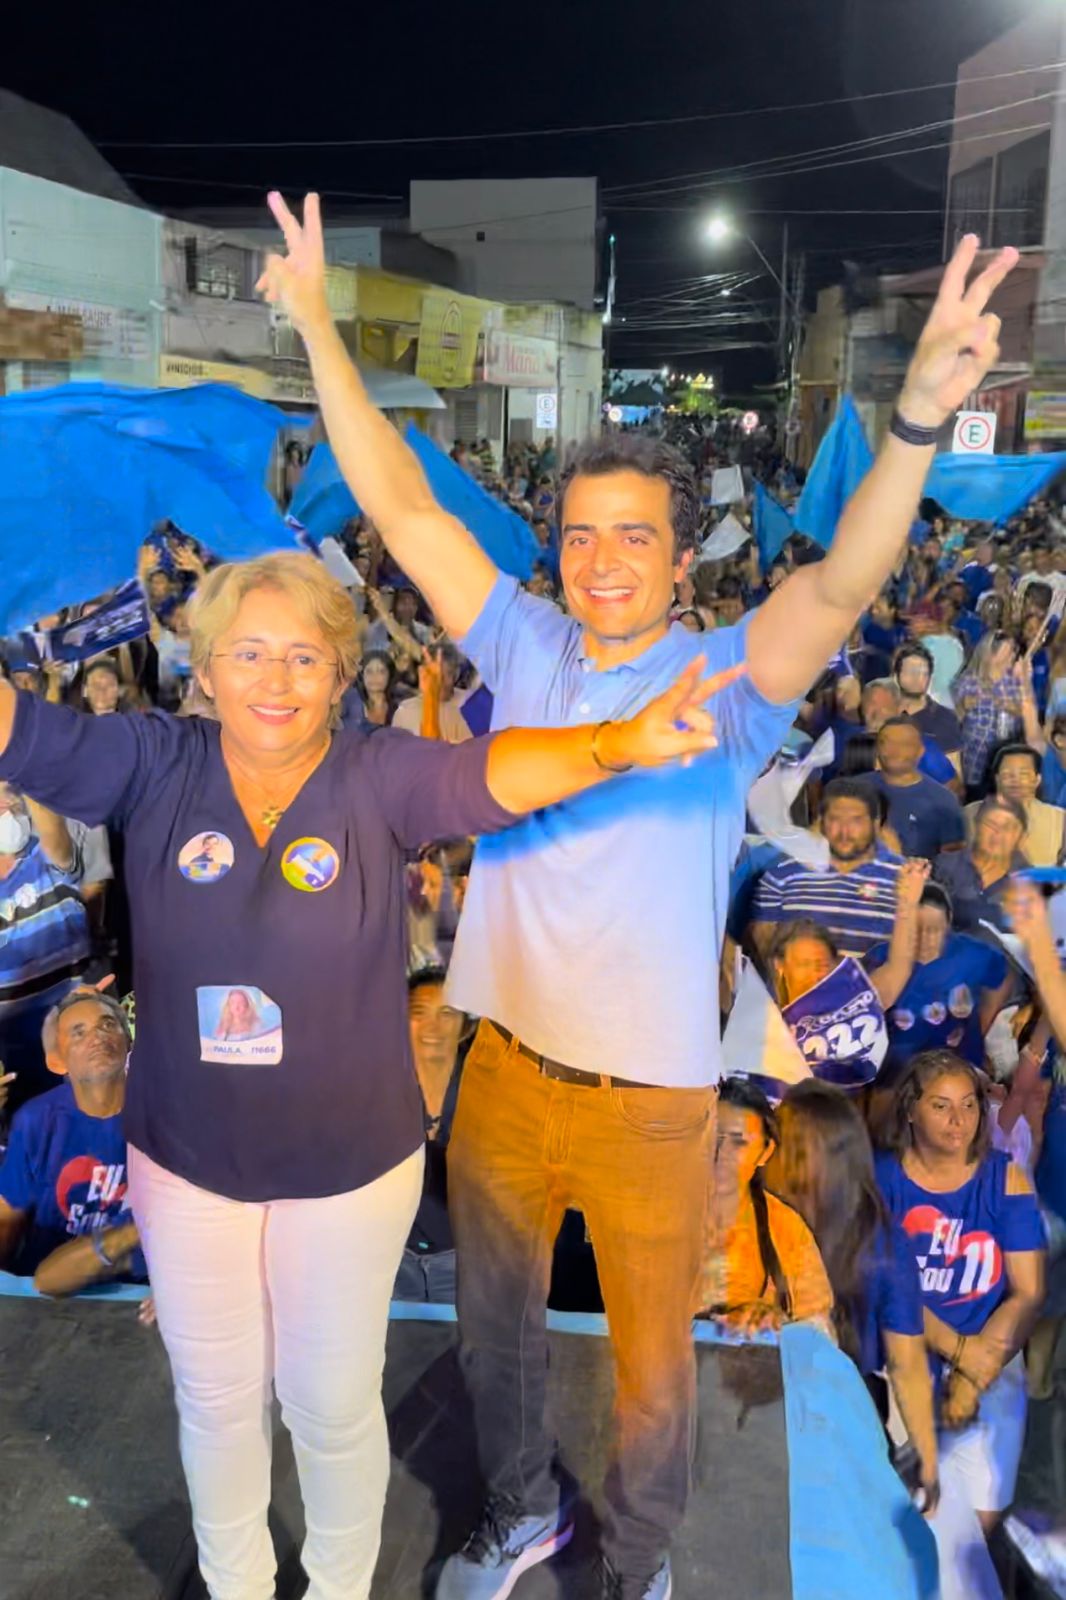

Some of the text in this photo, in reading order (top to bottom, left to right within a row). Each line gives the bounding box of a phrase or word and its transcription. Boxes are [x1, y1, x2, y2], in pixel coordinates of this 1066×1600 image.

[968, 424, 981, 443] E
[87, 1164, 124, 1202] EU
[928, 1217, 963, 1255] EU
[958, 1239, 995, 1294] 11
